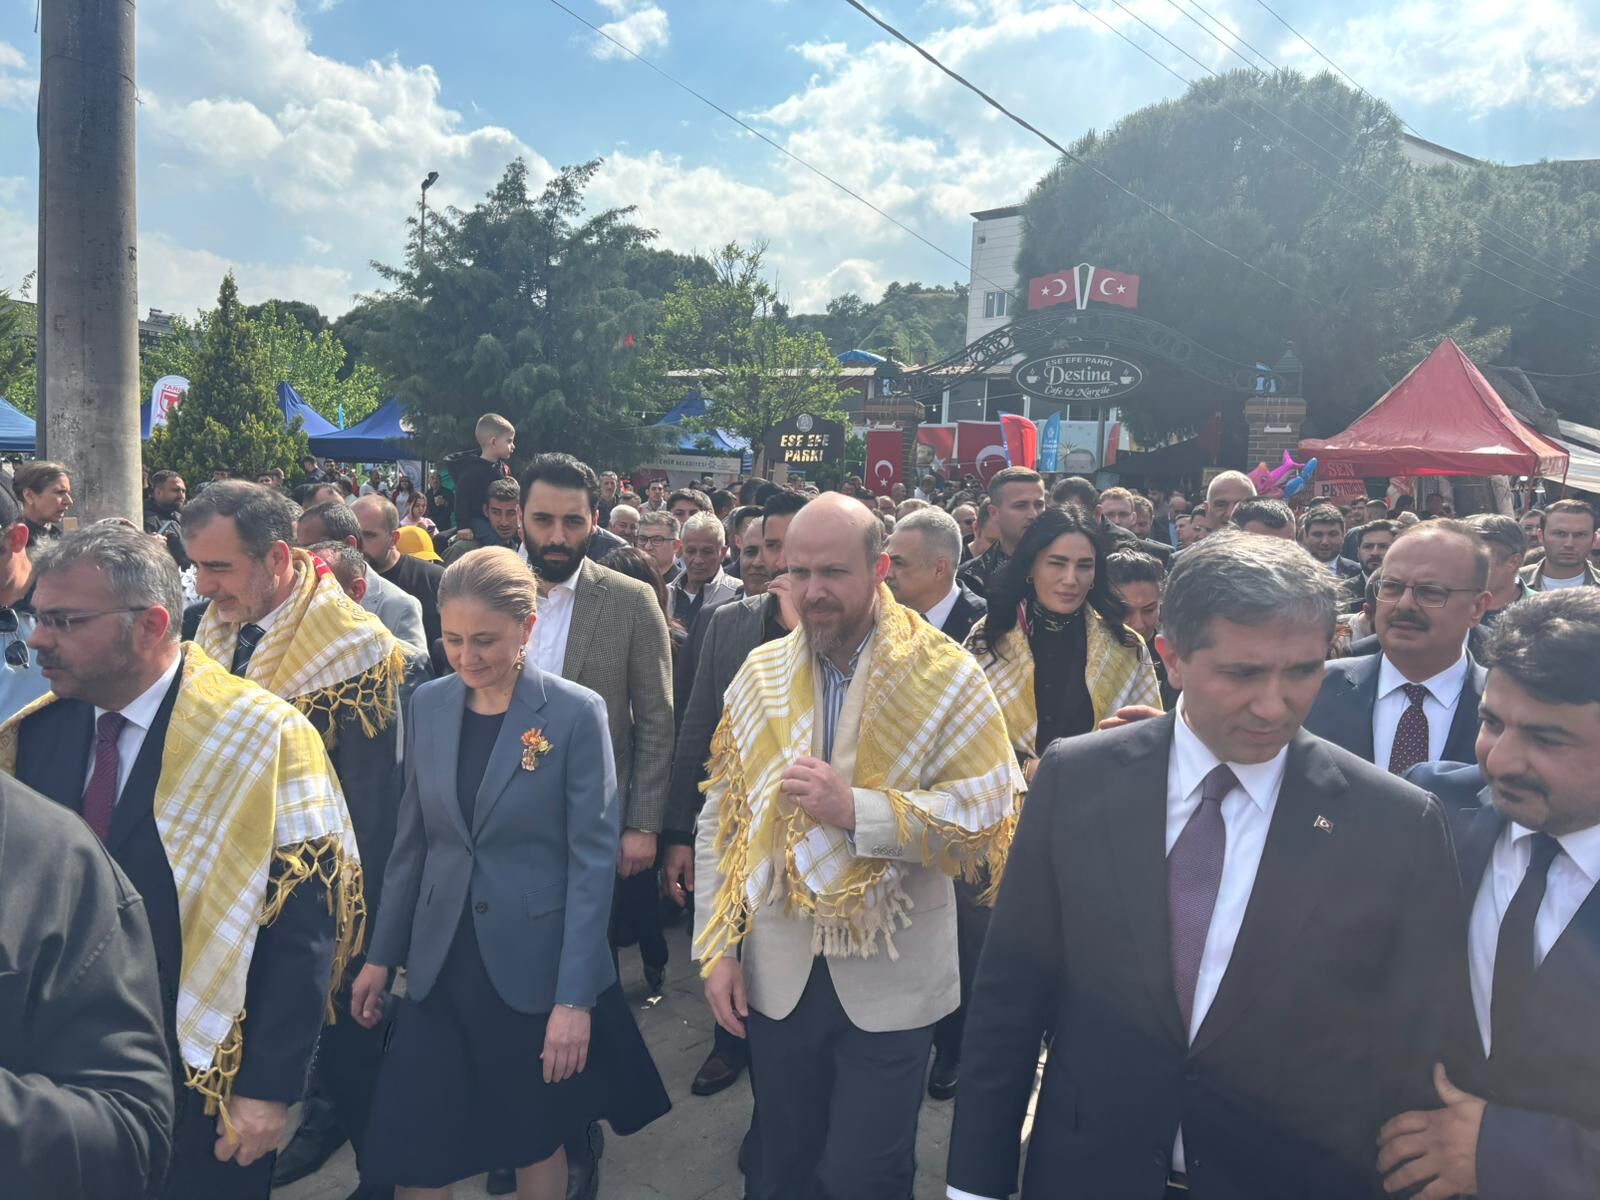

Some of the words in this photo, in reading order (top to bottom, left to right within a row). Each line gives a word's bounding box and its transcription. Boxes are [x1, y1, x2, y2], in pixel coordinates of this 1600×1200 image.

[1045, 359, 1063, 367] ESE
[1085, 357, 1113, 367] PARKI
[1043, 365, 1111, 385] Destina
[1044, 385, 1062, 396] Cafe
[780, 434, 804, 447] ESE
[807, 433, 830, 447] EFE
[784, 449, 824, 462] PARKI
